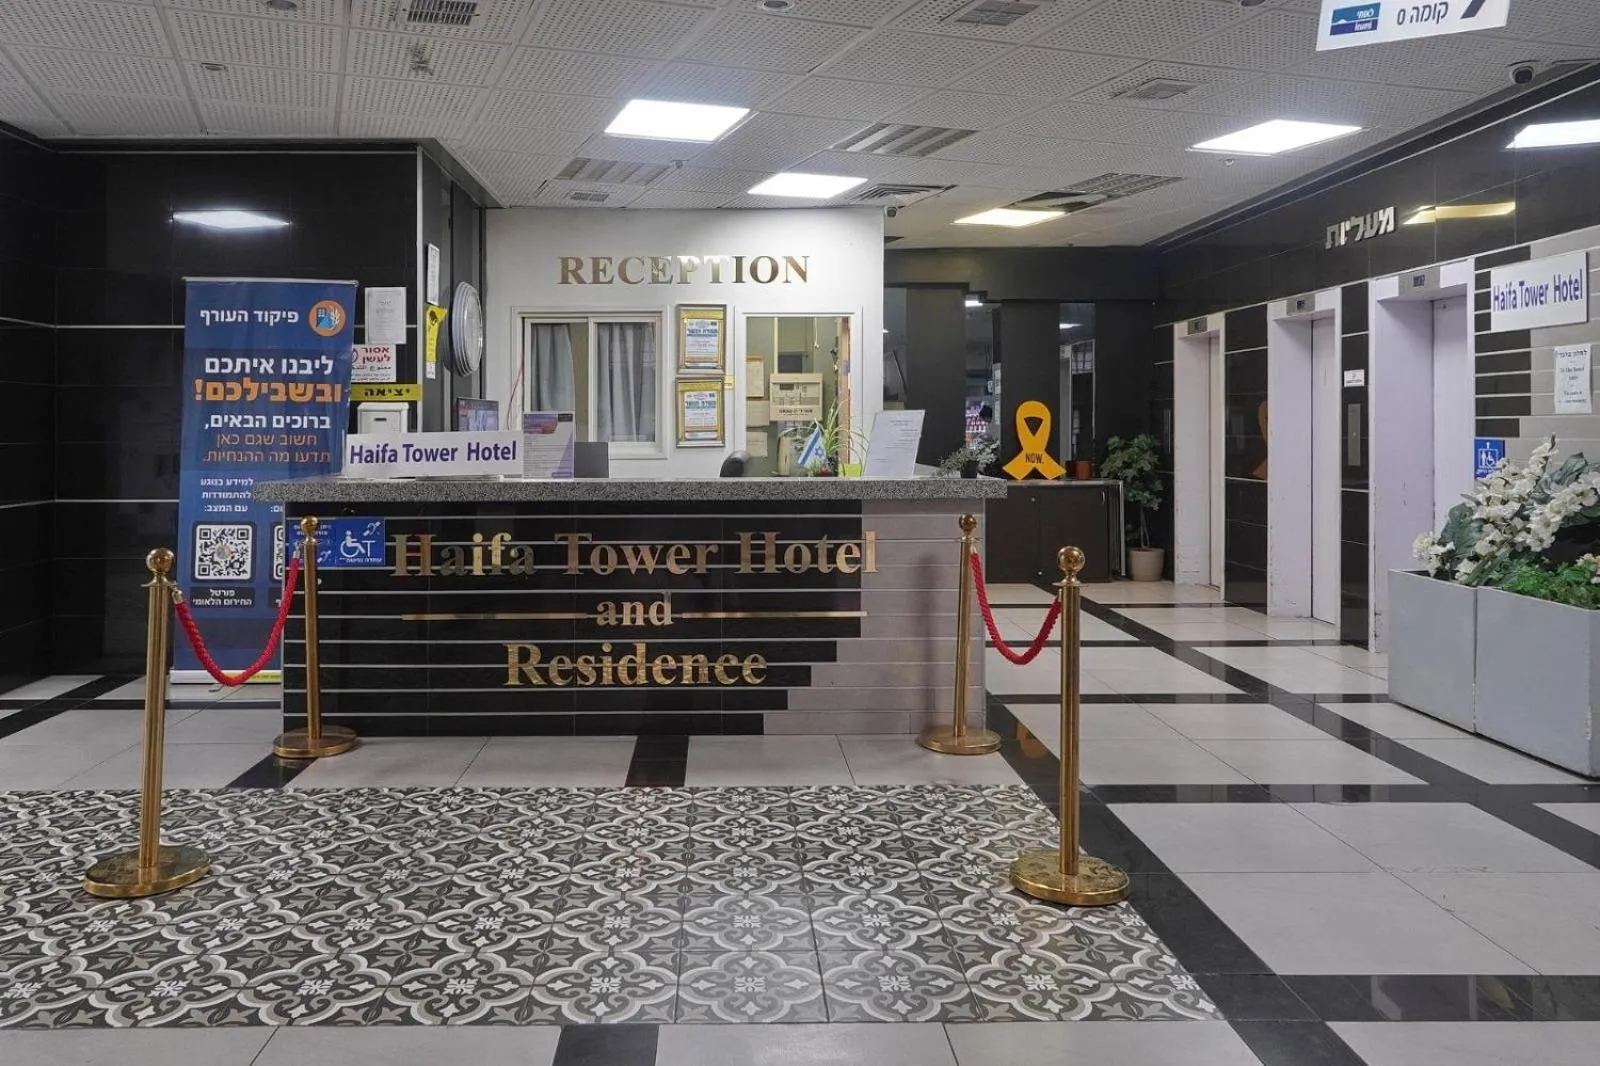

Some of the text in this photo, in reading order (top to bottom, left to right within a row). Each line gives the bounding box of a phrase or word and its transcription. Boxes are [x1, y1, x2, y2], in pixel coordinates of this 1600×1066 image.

[1409, 2, 1449, 24] קומה
[1325, 206, 1395, 249] מעליות
[556, 255, 810, 285] RECEPTION
[1493, 268, 1583, 312] Haifa Tower Hotel
[200, 310, 299, 326] פיקוד העורף
[205, 355, 334, 375] ליבנו איתכם
[362, 354, 391, 364] לעשן
[194, 377, 342, 402] ובשבילכם!
[364, 387, 410, 396] יציאה
[204, 414, 331, 429] ברוכים הבאים,
[216, 433, 317, 448] חשוב שגם כאן
[269, 451, 289, 462] מה
[295, 451, 330, 463] תדעו
[350, 443, 398, 464] Haifa
[402, 443, 458, 462] Tower
[467, 440, 517, 461] Hotel
[389, 530, 879, 577] Haifa Tower Hotel
[193, 598, 252, 606] החירום הלאומי
[209, 588, 235, 597] פורטל
[596, 591, 674, 627] and
[503, 641, 768, 687] Residence
